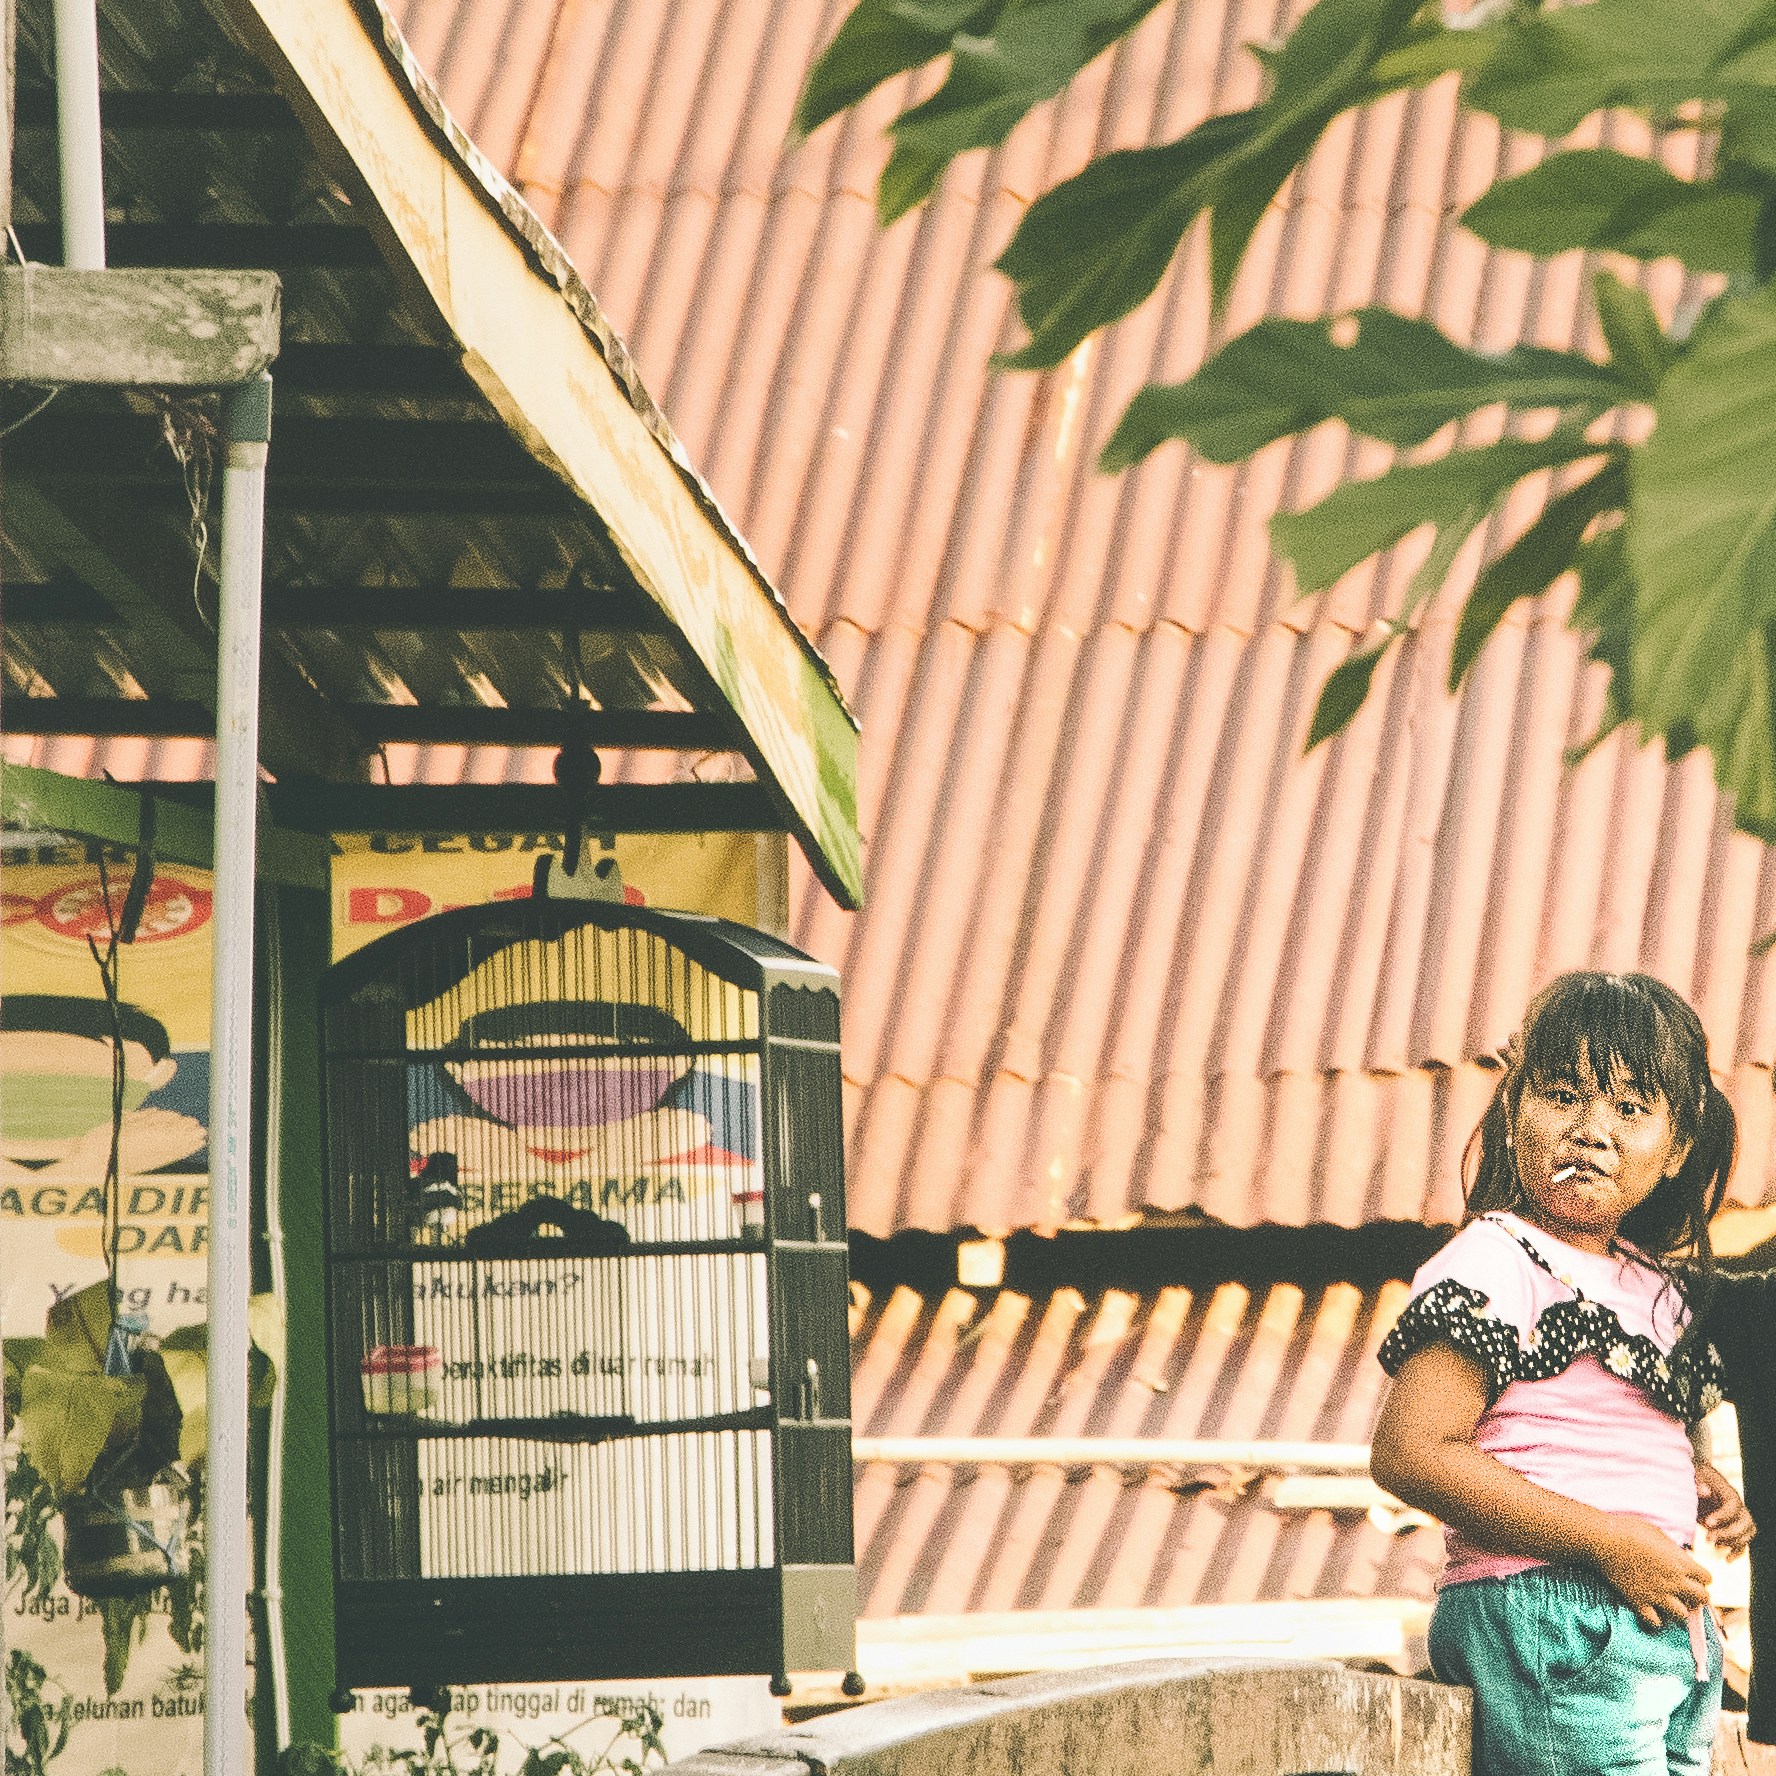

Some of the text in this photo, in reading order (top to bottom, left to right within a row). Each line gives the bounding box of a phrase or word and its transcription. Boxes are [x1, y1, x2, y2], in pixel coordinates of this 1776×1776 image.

[432, 1470, 462, 1497] air
[66, 1695, 144, 1721] eluhan
[486, 1687, 559, 1719] tinggal
[567, 1687, 585, 1711] di
[673, 1692, 711, 1718] dan
